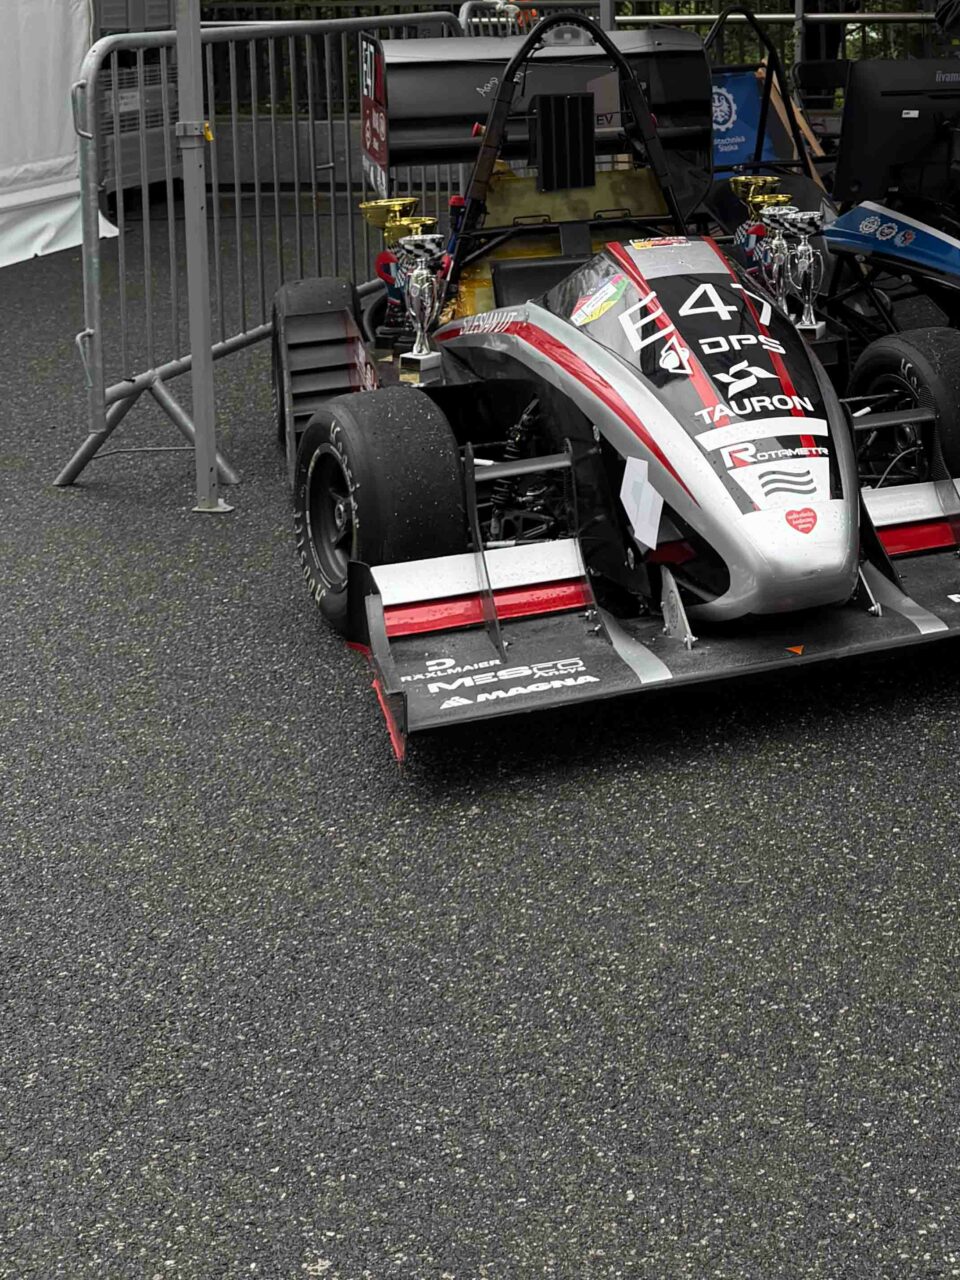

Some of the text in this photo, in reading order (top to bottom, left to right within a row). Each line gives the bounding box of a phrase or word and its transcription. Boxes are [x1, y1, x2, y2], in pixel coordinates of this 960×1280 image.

[698, 334, 786, 355] DPS
[694, 394, 815, 425] TAURON
[476, 675, 600, 703] MAGNA
